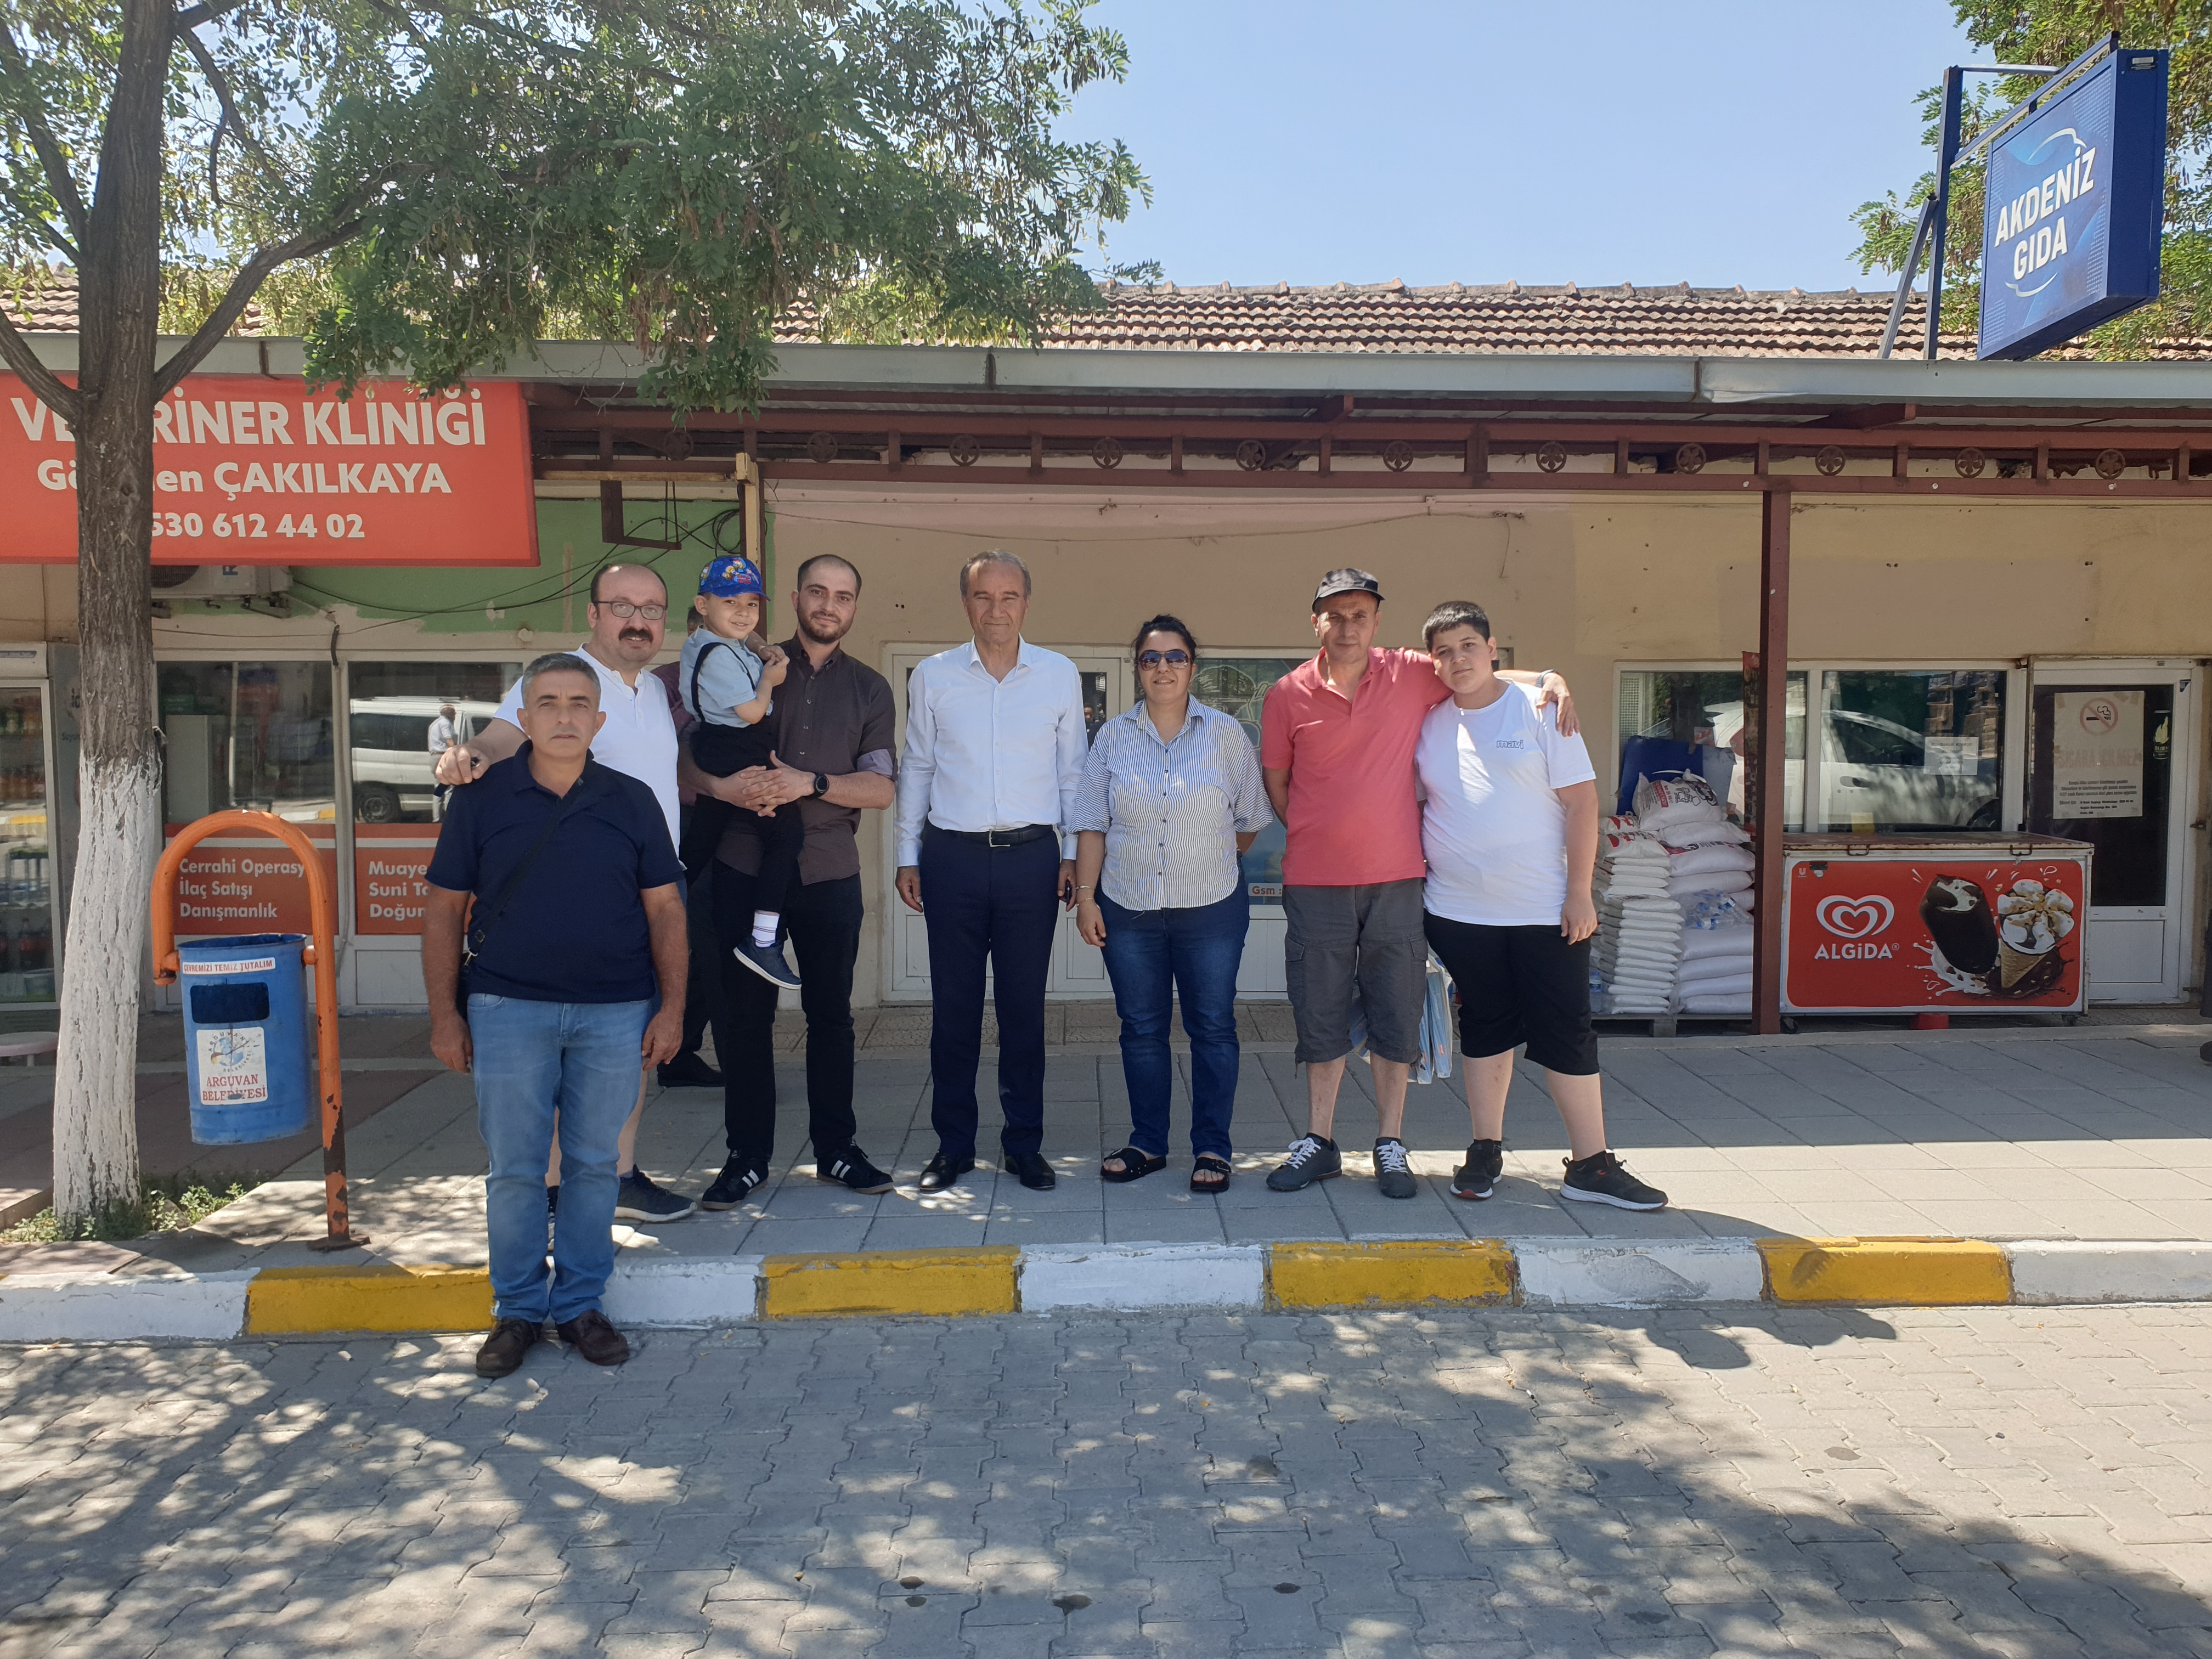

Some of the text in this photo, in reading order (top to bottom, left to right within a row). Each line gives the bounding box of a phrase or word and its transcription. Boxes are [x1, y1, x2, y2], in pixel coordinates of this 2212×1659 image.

[1994, 146, 2096, 248] AKDENİZ
[2014, 216, 2068, 280] GIDA
[10, 387, 486, 445] VERİNER KLİNİĞİ
[37, 459, 452, 501] Gen ÇAKILKAYA
[153, 513, 365, 538] 530 612 44 02
[1496, 739, 1524, 749] mavi
[179, 858, 304, 878] Cerrahi Operasy
[369, 861, 427, 879] Muaye
[179, 877, 253, 900] İlaç Satışı
[369, 882, 407, 897] Suni
[1252, 885, 1276, 895] Gsm
[180, 902, 278, 922] Danışmanlık
[184, 962, 212, 973] ÇEVREMİZİ
[240, 960, 273, 972] TUTALIM
[206, 1074, 259, 1087] ARGUVAN
